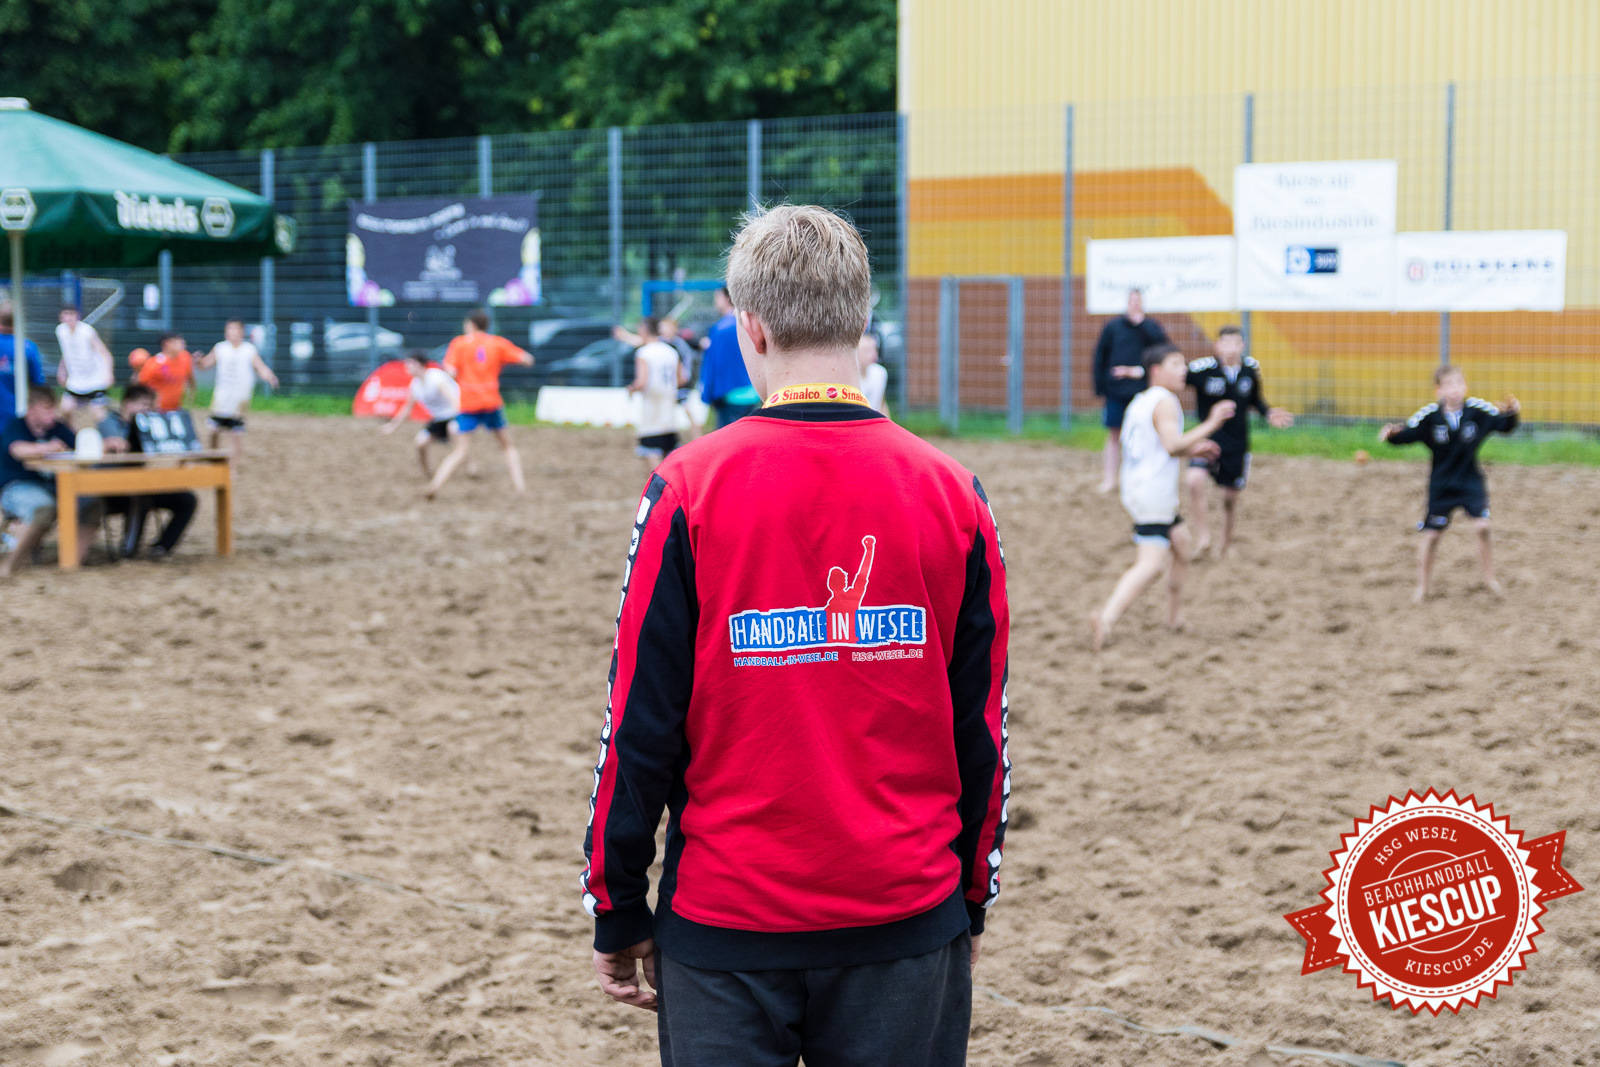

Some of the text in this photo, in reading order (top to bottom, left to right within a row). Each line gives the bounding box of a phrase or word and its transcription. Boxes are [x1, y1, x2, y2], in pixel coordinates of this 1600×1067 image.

[782, 388, 820, 401] Sinalco
[734, 611, 921, 645] HANDBALL IN WESEL
[733, 649, 923, 667] HANDBALL-IN-WESEL.DE HSG-WESEL.DE
